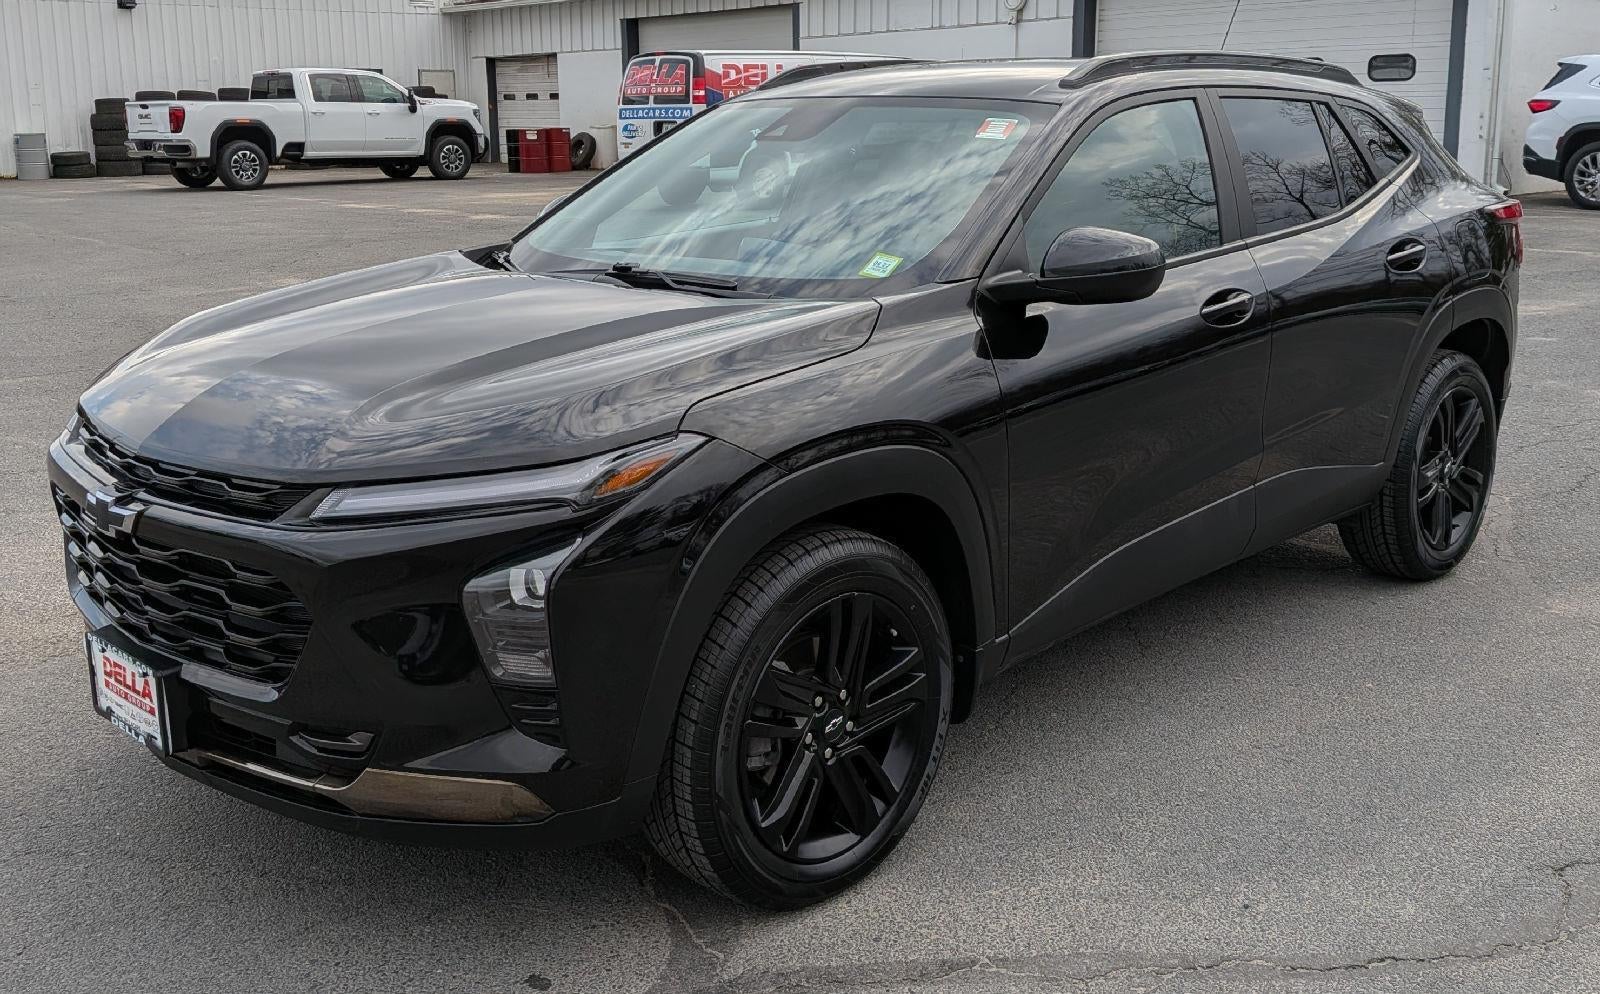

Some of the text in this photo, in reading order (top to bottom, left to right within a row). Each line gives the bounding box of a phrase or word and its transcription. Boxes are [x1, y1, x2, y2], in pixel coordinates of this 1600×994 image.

[626, 64, 686, 85] DELLA
[650, 86, 682, 94] GROUP
[621, 108, 691, 118] DELLACARS.COM
[87, 632, 154, 675] DELLACARS.COM
[102, 653, 155, 704] DELLA
[109, 683, 151, 711] AUTO GROUP
[111, 717, 147, 746] DELLA
